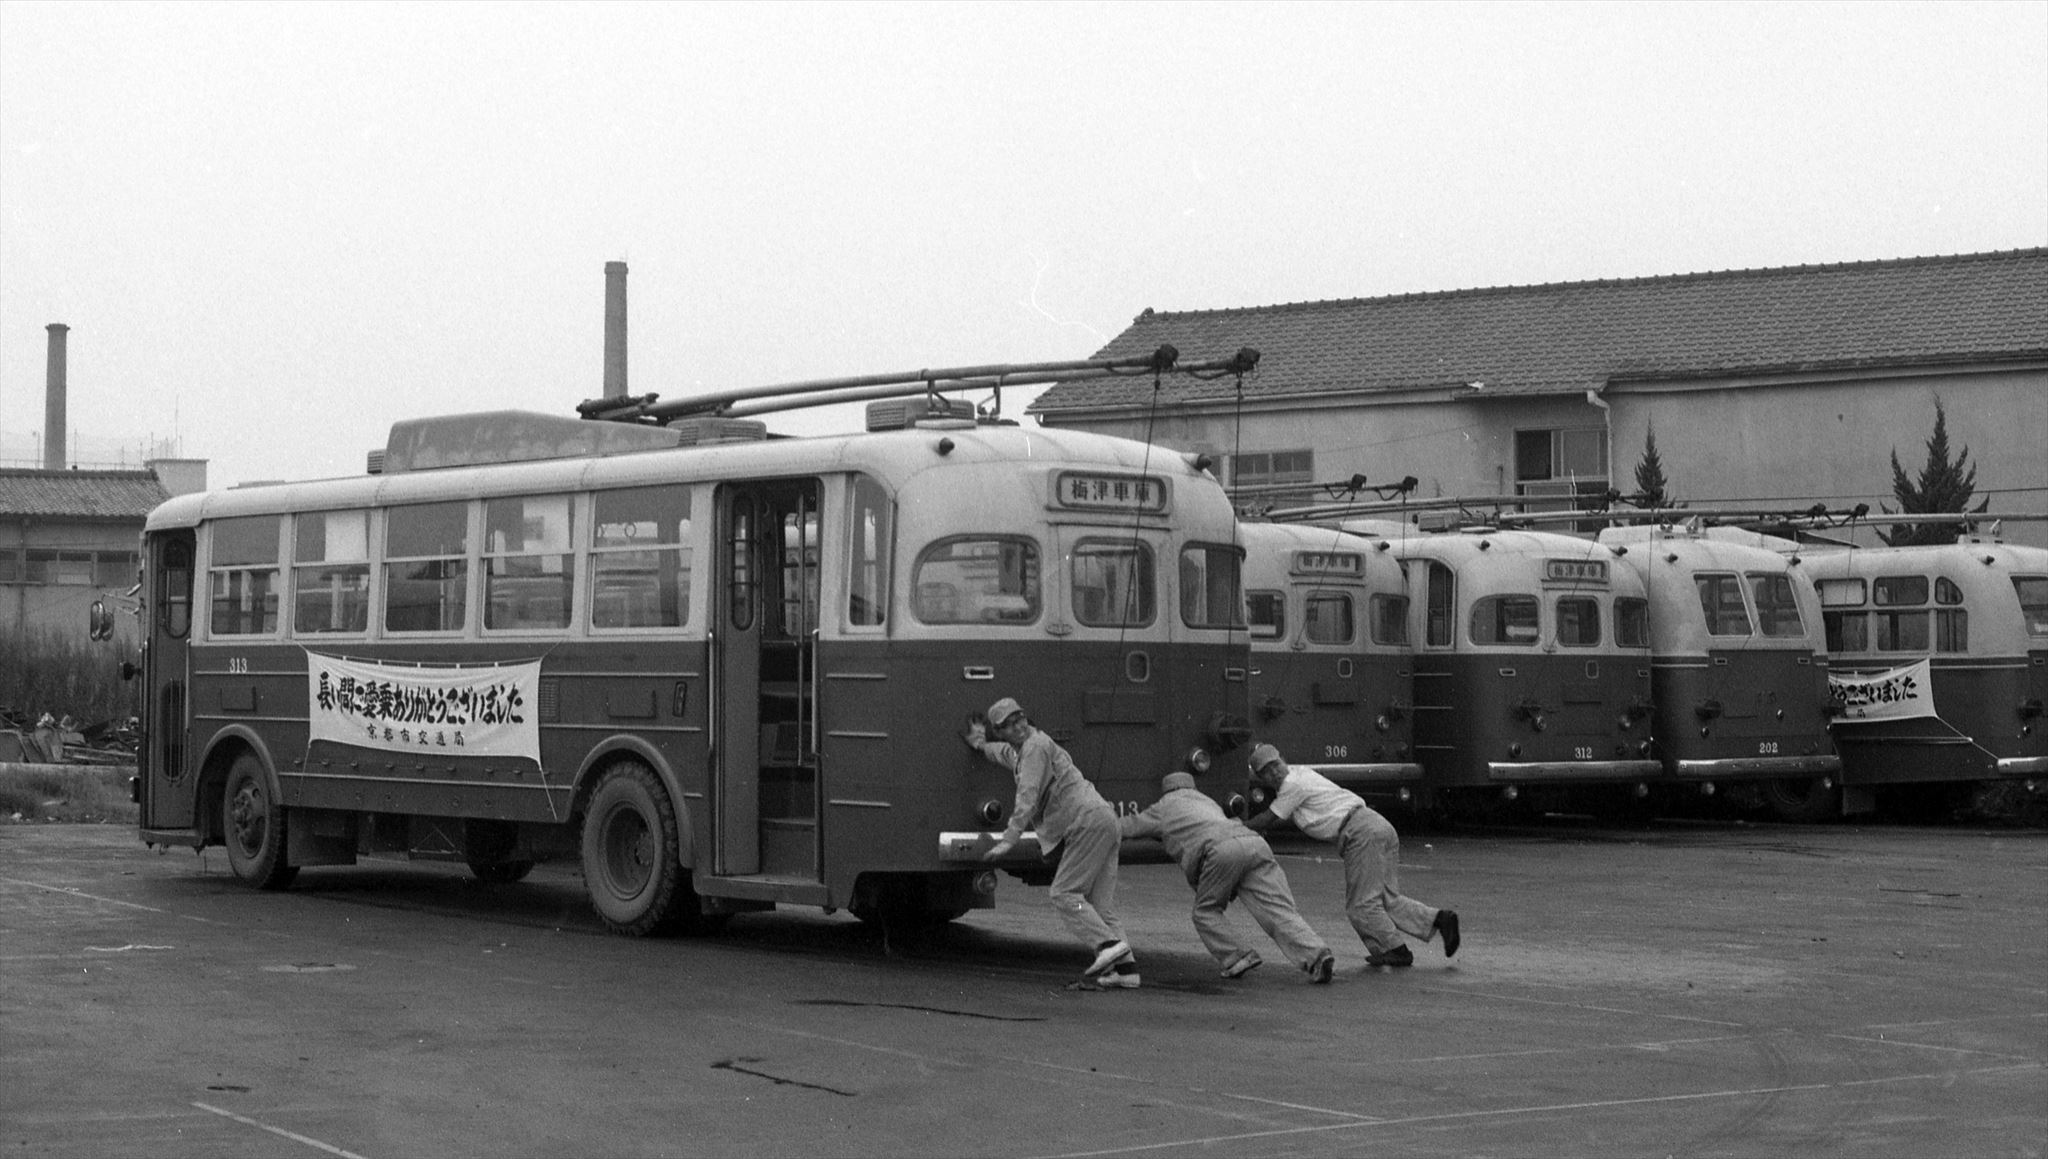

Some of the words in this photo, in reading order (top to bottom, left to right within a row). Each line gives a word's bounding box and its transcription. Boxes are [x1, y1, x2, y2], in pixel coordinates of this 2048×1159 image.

[1071, 478, 1150, 503] 梅津車庫
[229, 657, 248, 674] 313
[317, 671, 524, 725] 長い間ご愛乗ありがとうございました
[366, 723, 464, 747] 京都市交通局
[1325, 745, 1348, 758] 306
[1574, 746, 1593, 759] 312
[1759, 742, 1778, 754] 202
[1109, 800, 1139, 818] 13
